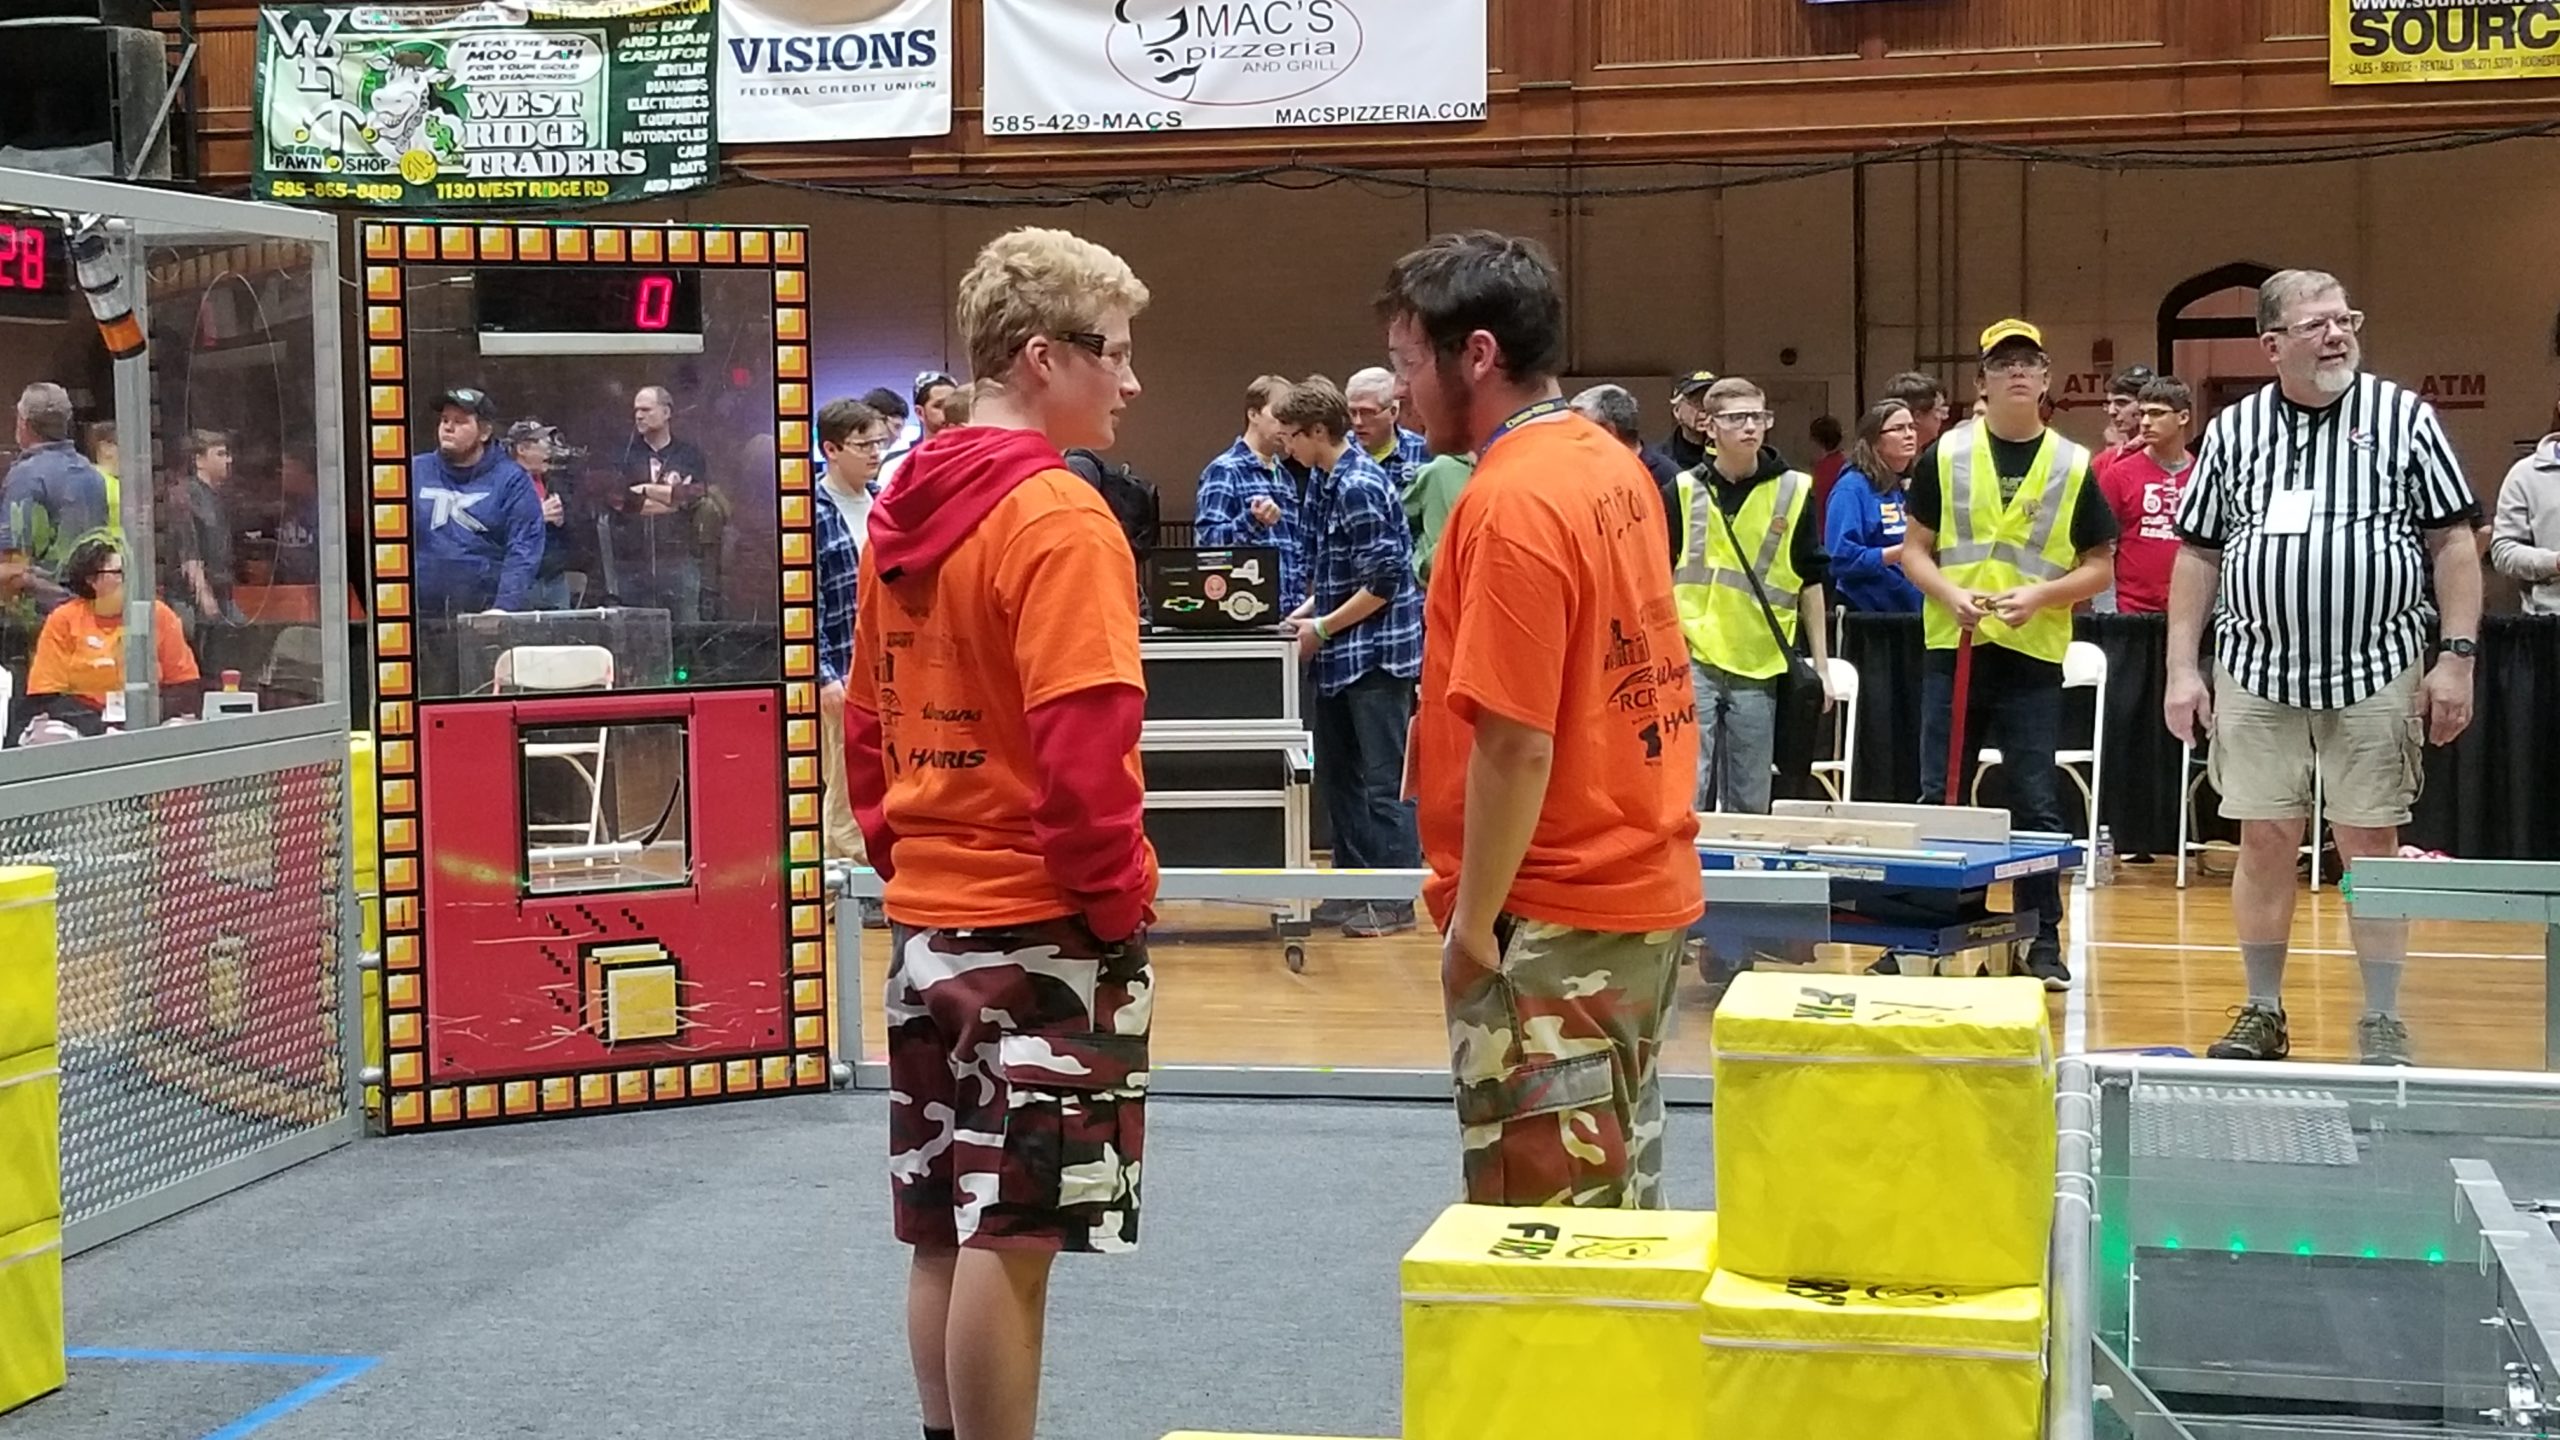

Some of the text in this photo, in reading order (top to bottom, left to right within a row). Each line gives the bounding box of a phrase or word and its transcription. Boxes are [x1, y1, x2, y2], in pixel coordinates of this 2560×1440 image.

[628, 18, 698, 33] WE BUY
[1196, 0, 1335, 38] MAC'S
[617, 32, 711, 49] AND LOAN
[2349, 6, 2560, 57] SOURC
[458, 39, 586, 48] WE PAY THE MOST
[727, 29, 938, 74] VISIONS
[1186, 38, 1336, 65] pizzeria
[466, 49, 583, 61] MOO-LAH
[618, 47, 708, 63] CASH FOR
[499, 63, 537, 71] YOUR
[1242, 60, 1340, 74] AND GRILL
[2349, 62, 2373, 75] SALES
[2420, 58, 2454, 71] RENTALS
[740, 81, 937, 97] FEDERAL CREDIT UNION
[462, 91, 584, 119] WEST
[1275, 102, 1487, 124] MACSPIZZERIA.COM
[991, 110, 1183, 133] 585-429-MACS
[463, 121, 587, 149] RIDGE
[622, 127, 709, 144] MOTORCYCLES
[274, 155, 392, 172] PAWN SHOP
[463, 149, 648, 178] TRADERS
[435, 180, 610, 199] 1130 WEST RIDGE RD
[637, 277, 673, 329] 0
[2420, 374, 2486, 396] ATM
